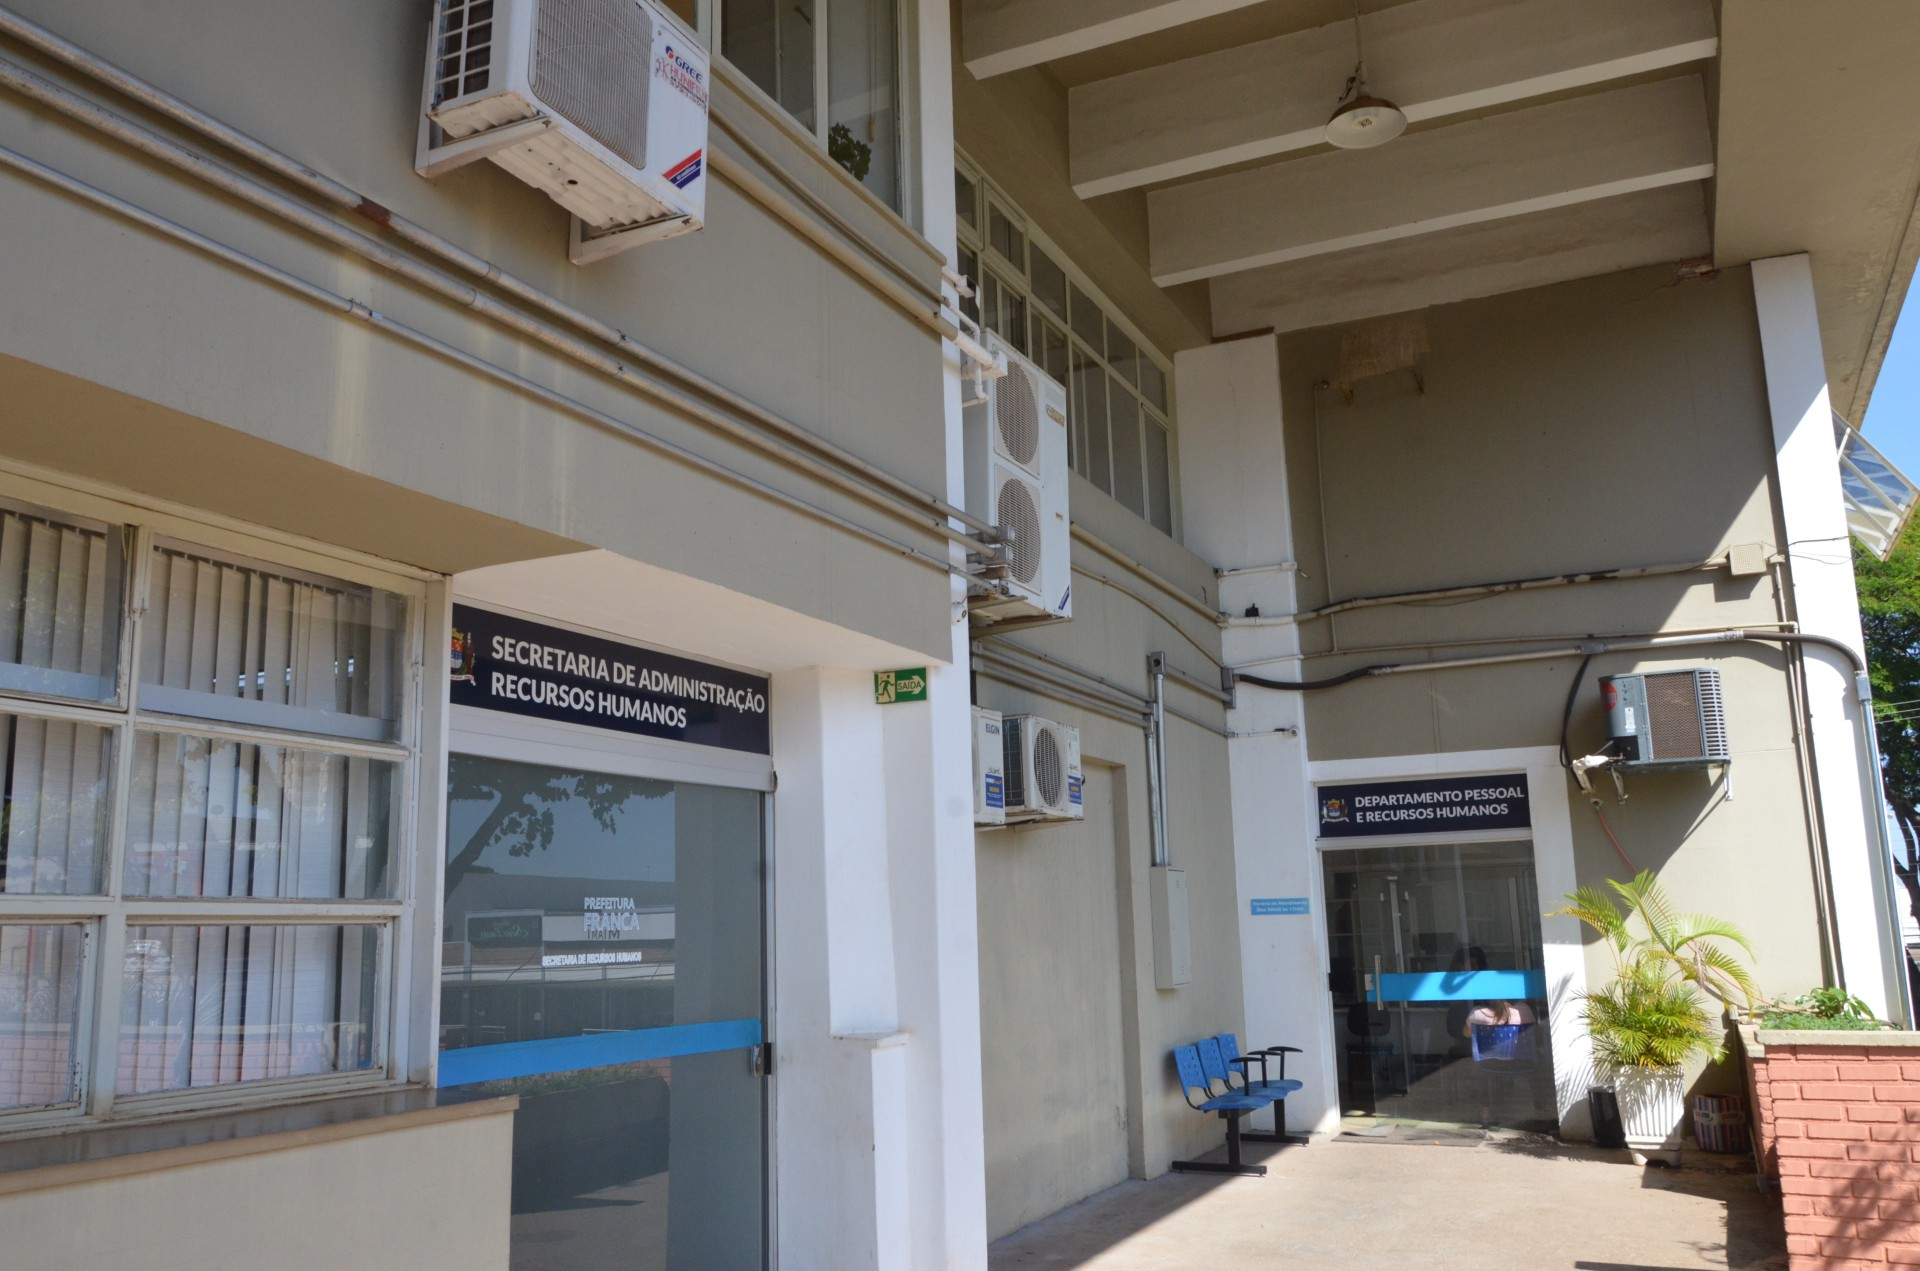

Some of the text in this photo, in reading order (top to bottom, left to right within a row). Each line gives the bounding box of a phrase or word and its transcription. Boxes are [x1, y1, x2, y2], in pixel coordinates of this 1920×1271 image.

[675, 56, 703, 84] GREE
[492, 635, 765, 714] SECRETARIA DE ADMINISTRAÇÃO
[491, 671, 687, 728] RECURSOS HUMANOS
[985, 723, 1000, 735] ELGIN
[1355, 786, 1524, 808] DEPARTAMENTO PESSOAL
[1356, 803, 1509, 823] E RECURSOS HUMANOS
[584, 897, 635, 910] PREFEITURA
[583, 912, 640, 931] FRANCA
[542, 951, 642, 967] SECRETARIA DE RECURSOS HUMANOS
